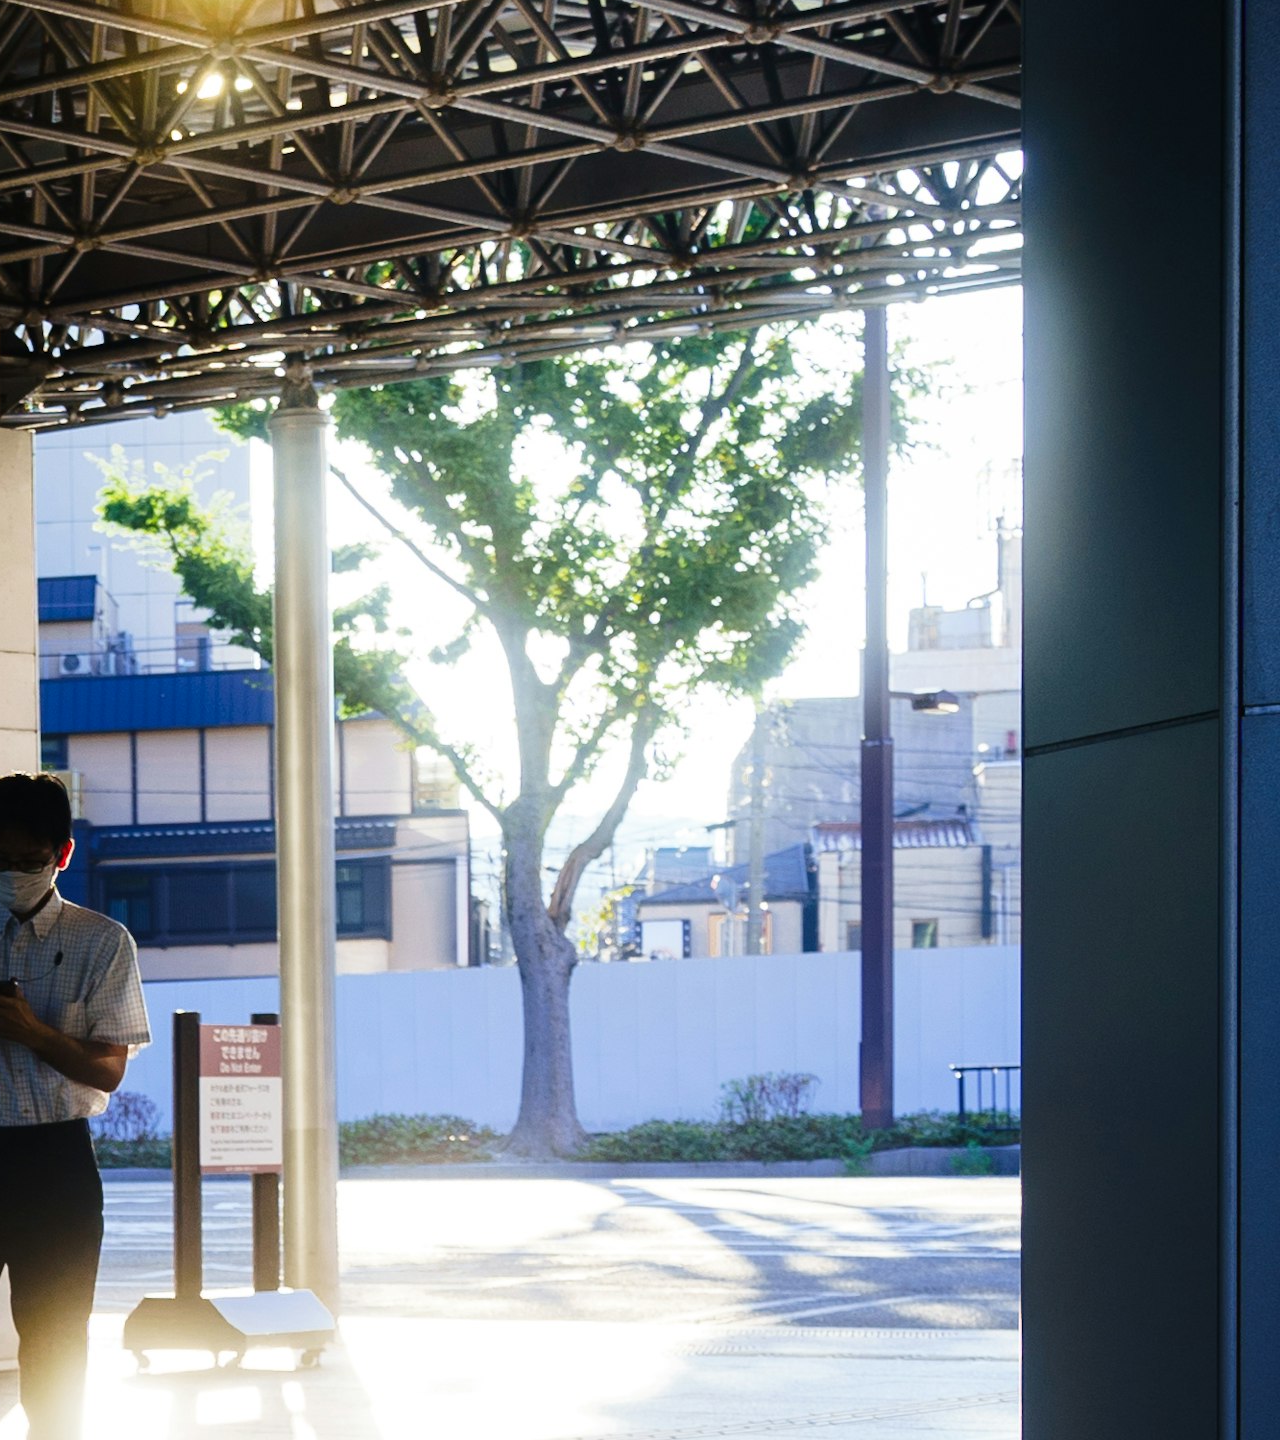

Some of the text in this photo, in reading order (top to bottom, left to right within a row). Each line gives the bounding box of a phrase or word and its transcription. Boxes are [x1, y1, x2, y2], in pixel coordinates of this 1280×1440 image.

[212, 1028, 268, 1044] この先通り抜け
[220, 1045, 261, 1061] できません
[219, 1062, 262, 1074] Do Not Enter
